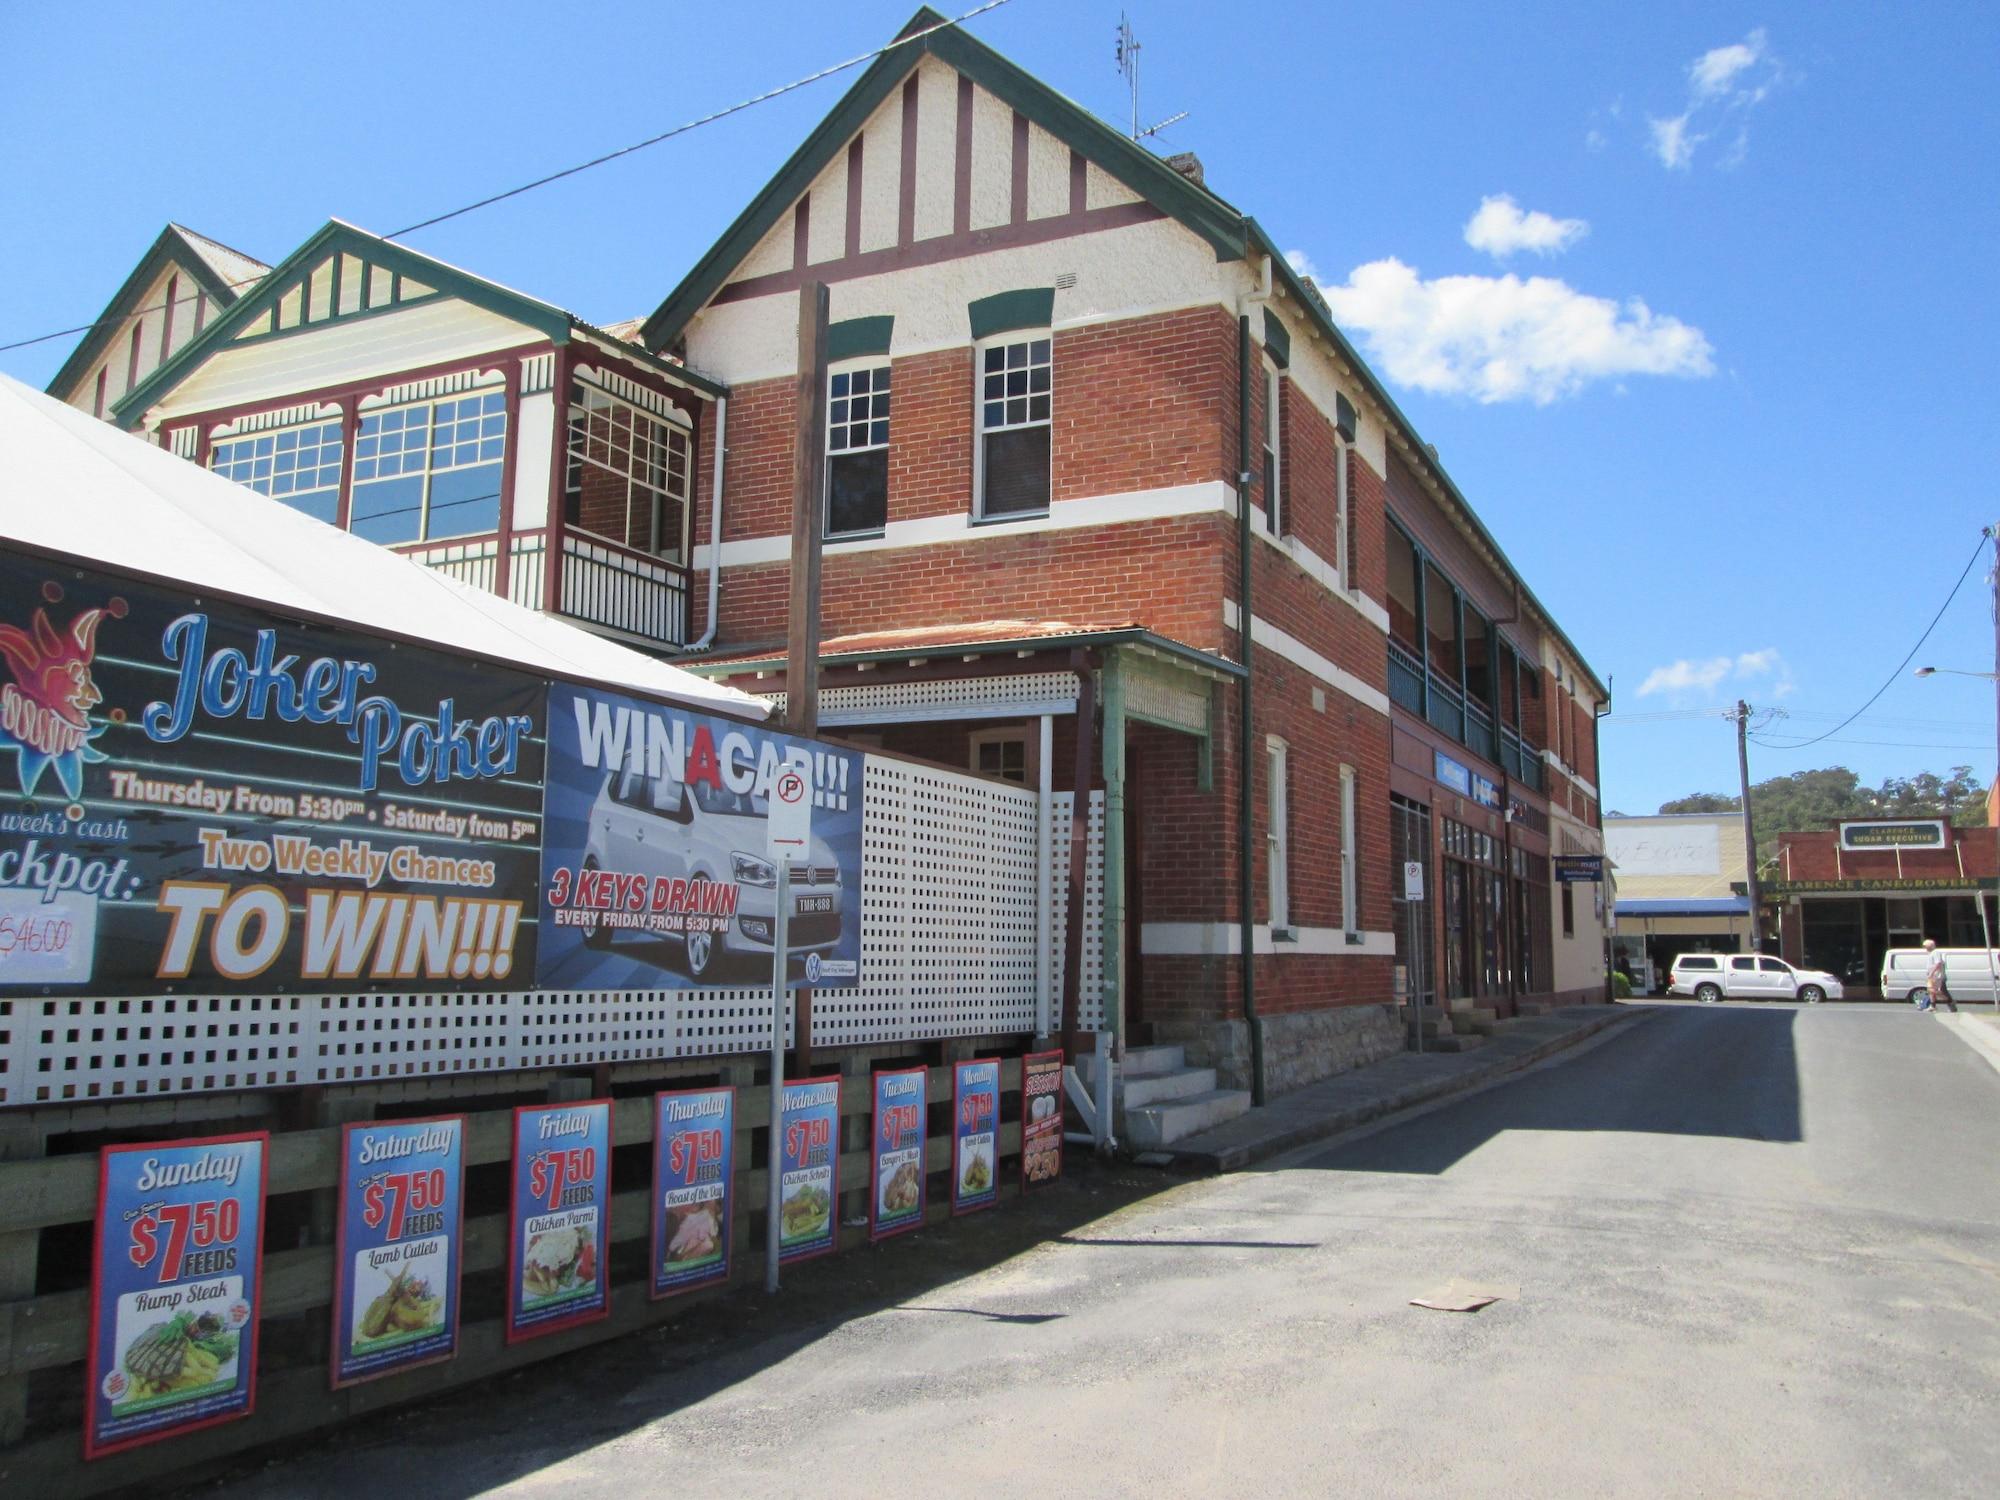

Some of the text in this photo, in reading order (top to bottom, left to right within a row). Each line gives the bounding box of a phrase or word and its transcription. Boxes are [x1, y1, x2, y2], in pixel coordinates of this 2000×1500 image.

[143, 613, 376, 742] Joker
[346, 696, 532, 791] Poker
[573, 696, 686, 784] WIN
[684, 724, 723, 790] A
[110, 770, 536, 841] Thursday From 5:30pm Saturday from 5pm
[0, 812, 129, 840] week's cash
[1853, 833, 1933, 843] SUGAR EXECUTIVE
[199, 827, 496, 887] Two Weekly Chances
[548, 867, 740, 917] 3 KEYS DRAWN
[1776, 878, 1979, 890] CLARENCE CANEGROWERS
[156, 880, 524, 980] TO WIN!!!
[555, 909, 599, 927] EVERY
[650, 914, 683, 931] FROM
[685, 916, 709, 932] 5:30
[712, 918, 729, 933] PM
[782, 1087, 838, 1112] Wednesday
[883, 1078, 918, 1099] Tuesday
[666, 1096, 726, 1123] Thursday
[538, 1113, 591, 1140] Friday
[900, 1132, 918, 1147] FEEDS
[359, 1127, 454, 1165] Saturday
[808, 1148, 830, 1166] FEEDS
[137, 1151, 242, 1192] Sunday
[696, 1163, 721, 1180] FEEDS
[783, 1172, 808, 1186] Chicken
[562, 1185, 594, 1207] FEEDS
[404, 1211, 444, 1237] FEEDS
[530, 1210, 595, 1234] Chicken Parmi
[183, 1246, 237, 1279] FEEDS
[369, 1240, 438, 1270] Lamb Cutlets
[135, 1279, 228, 1313] Rump Steak
